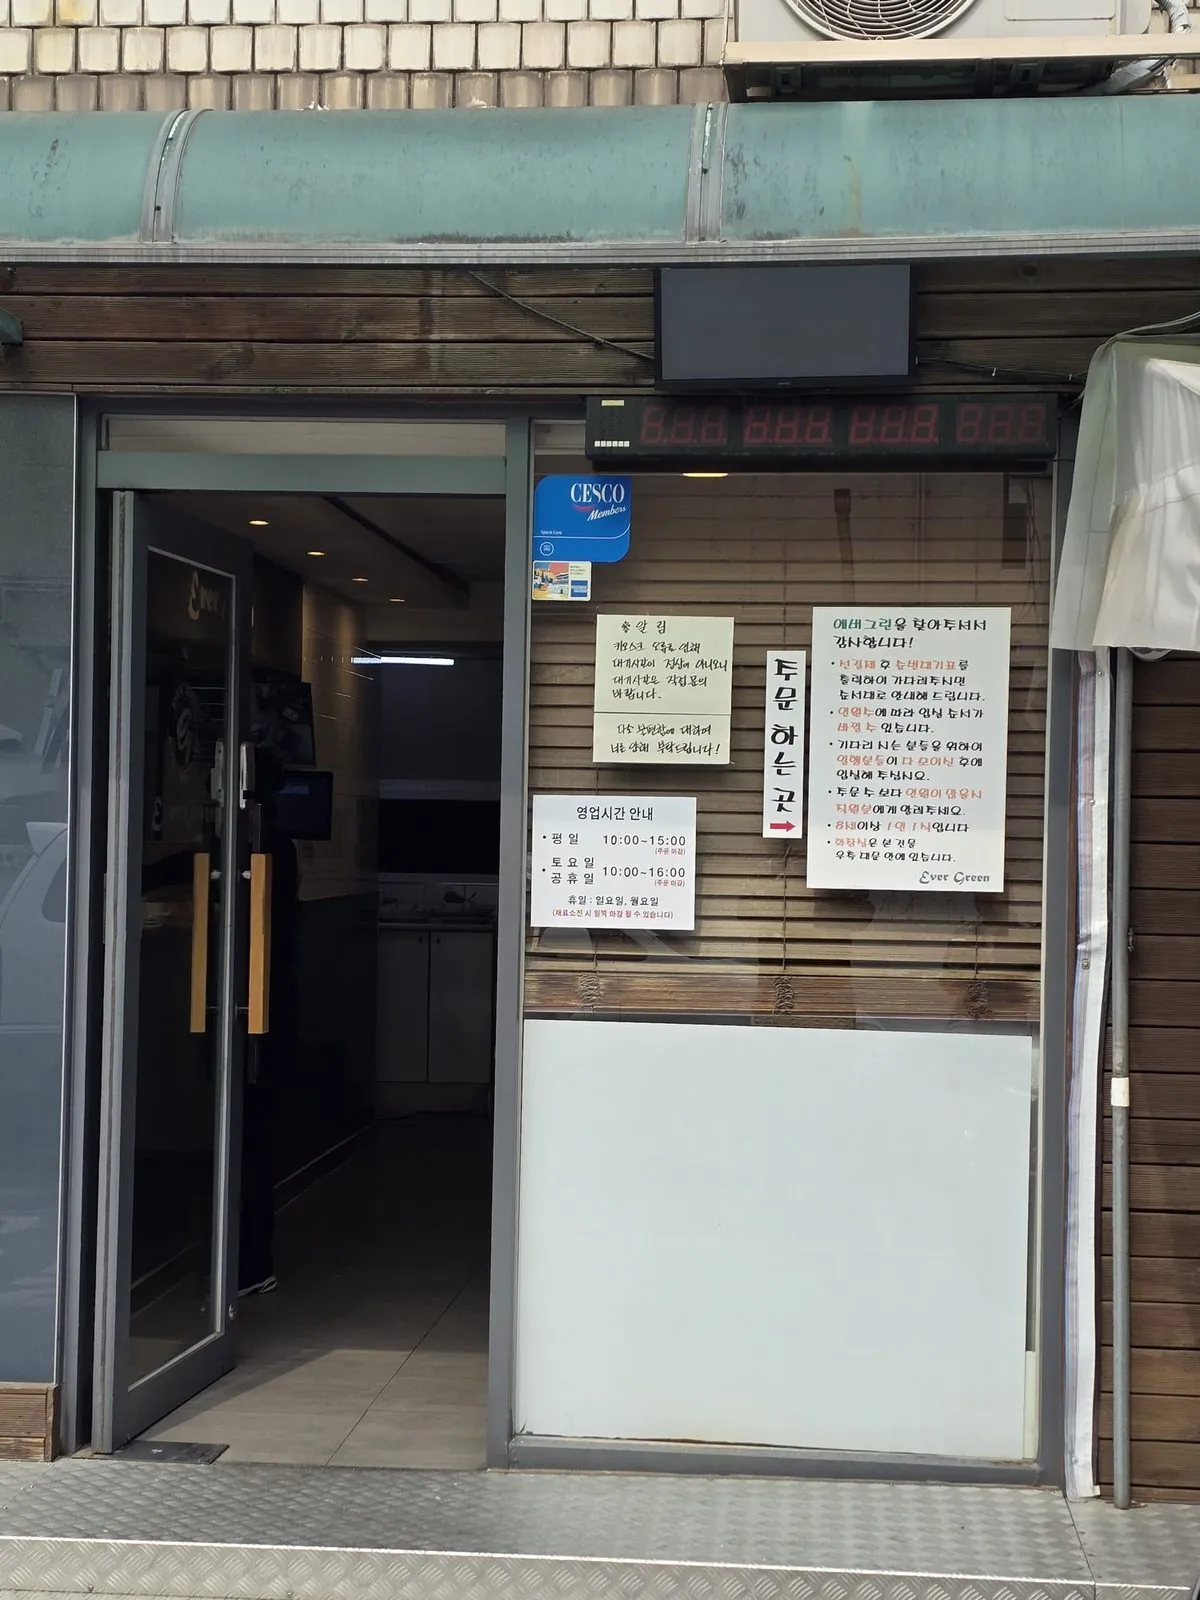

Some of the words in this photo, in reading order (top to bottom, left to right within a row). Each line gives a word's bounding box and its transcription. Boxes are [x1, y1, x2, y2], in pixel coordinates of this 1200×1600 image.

[570, 483, 625, 503] CESCO
[586, 505, 627, 521] Members
[833, 618, 906, 631] 에버그린을
[913, 617, 986, 631] 찾아주셔서
[613, 640, 645, 651] 키오스크
[679, 642, 700, 654] 인해
[833, 635, 913, 649] 감사합니다!
[612, 658, 655, 668] 대기시간이
[881, 659, 890, 670] 후
[612, 674, 660, 686] 대기시간은
[612, 688, 661, 700] 바랍니다.
[840, 690, 887, 700] 순서대로
[891, 691, 928, 700] 안내해
[932, 690, 985, 701] 드립니다.
[838, 707, 887, 717] 인원수에
[891, 708, 915, 717] 따라
[948, 708, 984, 718] 순서가
[680, 724, 711, 736] 대하여
[866, 722, 877, 732] 수
[881, 722, 934, 733] 있습니다.
[657, 740, 720, 756] 부탁드립니다!
[771, 724, 798, 776] 하는
[906, 740, 941, 751] 분들을
[946, 741, 982, 751] 위하여
[902, 757, 914, 765] 다
[959, 756, 982, 767] 후에
[772, 788, 796, 812] 곳
[577, 806, 625, 820] 영업시간
[630, 807, 653, 821] 안내
[603, 835, 685, 846] 10:00~15:00
[884, 852, 905, 861] 안에
[909, 852, 956, 862] 있습니다.
[603, 867, 685, 877] 10:00~16:00
[919, 871, 949, 884] Ever
[953, 872, 989, 885] Green
[568, 895, 586, 905] 휴일
[630, 896, 658, 906] 월요일
[643, 910, 673, 919] 있습니다)
